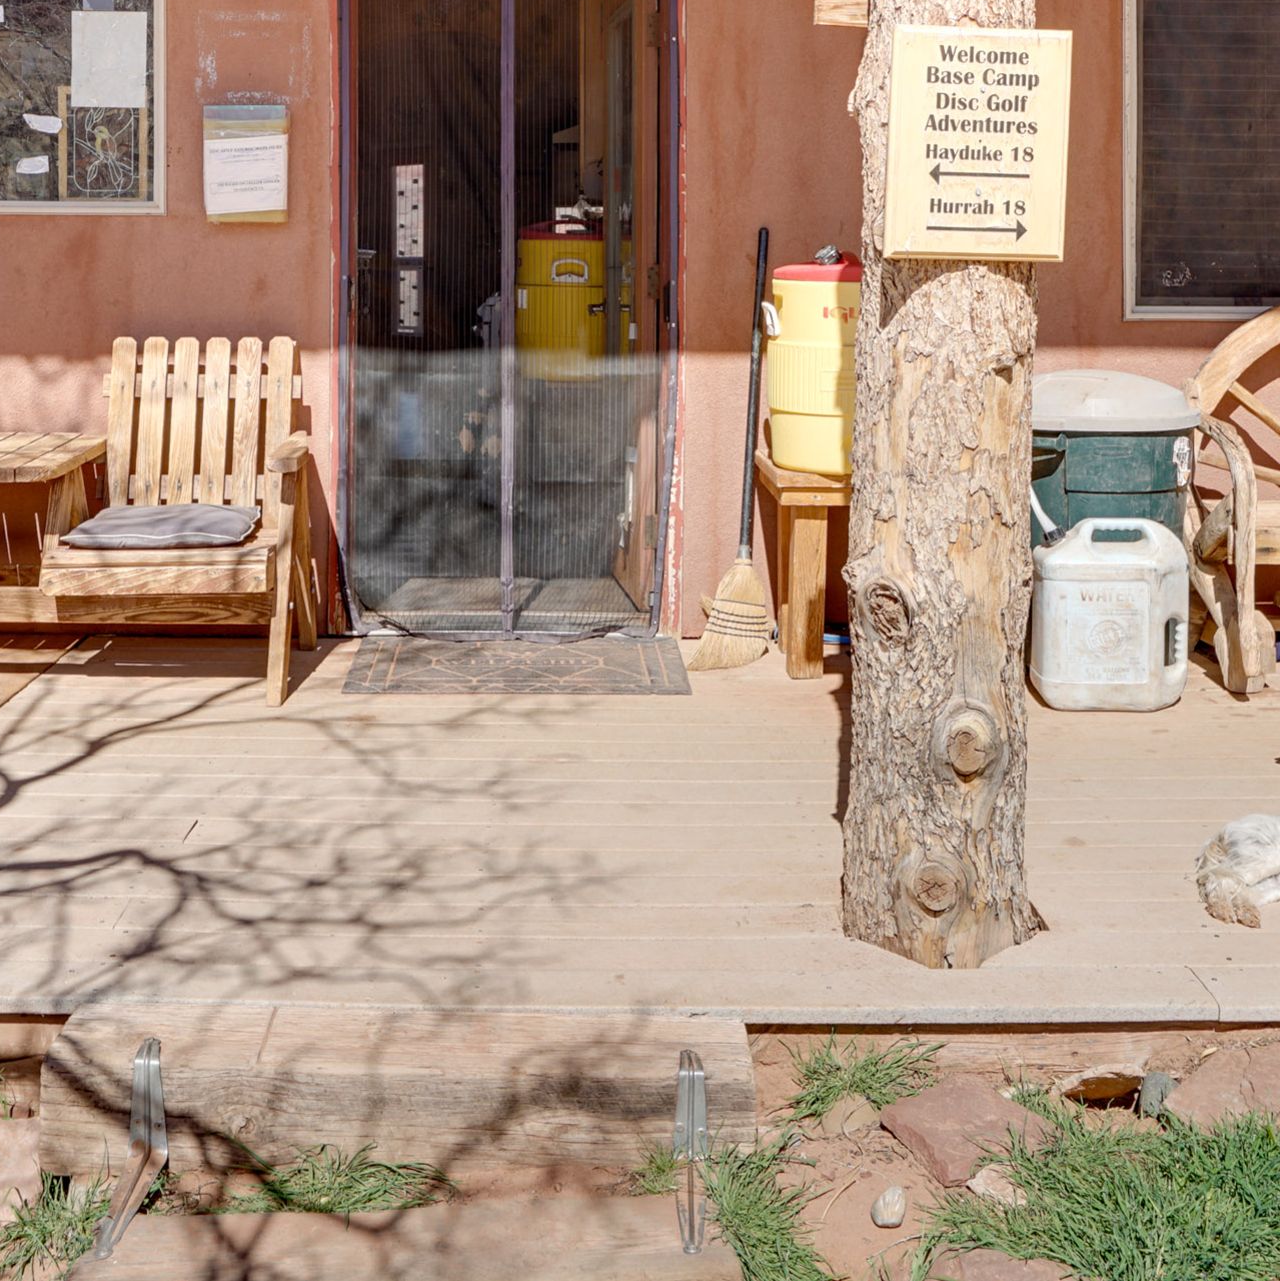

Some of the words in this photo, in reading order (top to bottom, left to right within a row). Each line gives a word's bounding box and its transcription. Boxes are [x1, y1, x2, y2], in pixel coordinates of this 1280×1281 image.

[939, 44, 1029, 65] Welcome
[926, 66, 975, 85] Base
[982, 68, 1040, 89] Camp
[936, 92, 979, 111] Disc
[986, 93, 1029, 113] Golf
[925, 114, 1038, 135] Adventures
[925, 143, 1003, 164] Hayduke
[1011, 146, 1034, 163] 18
[929, 198, 994, 215] Hurrah
[1003, 200, 1026, 216] 18
[822, 306, 860, 325] IGL
